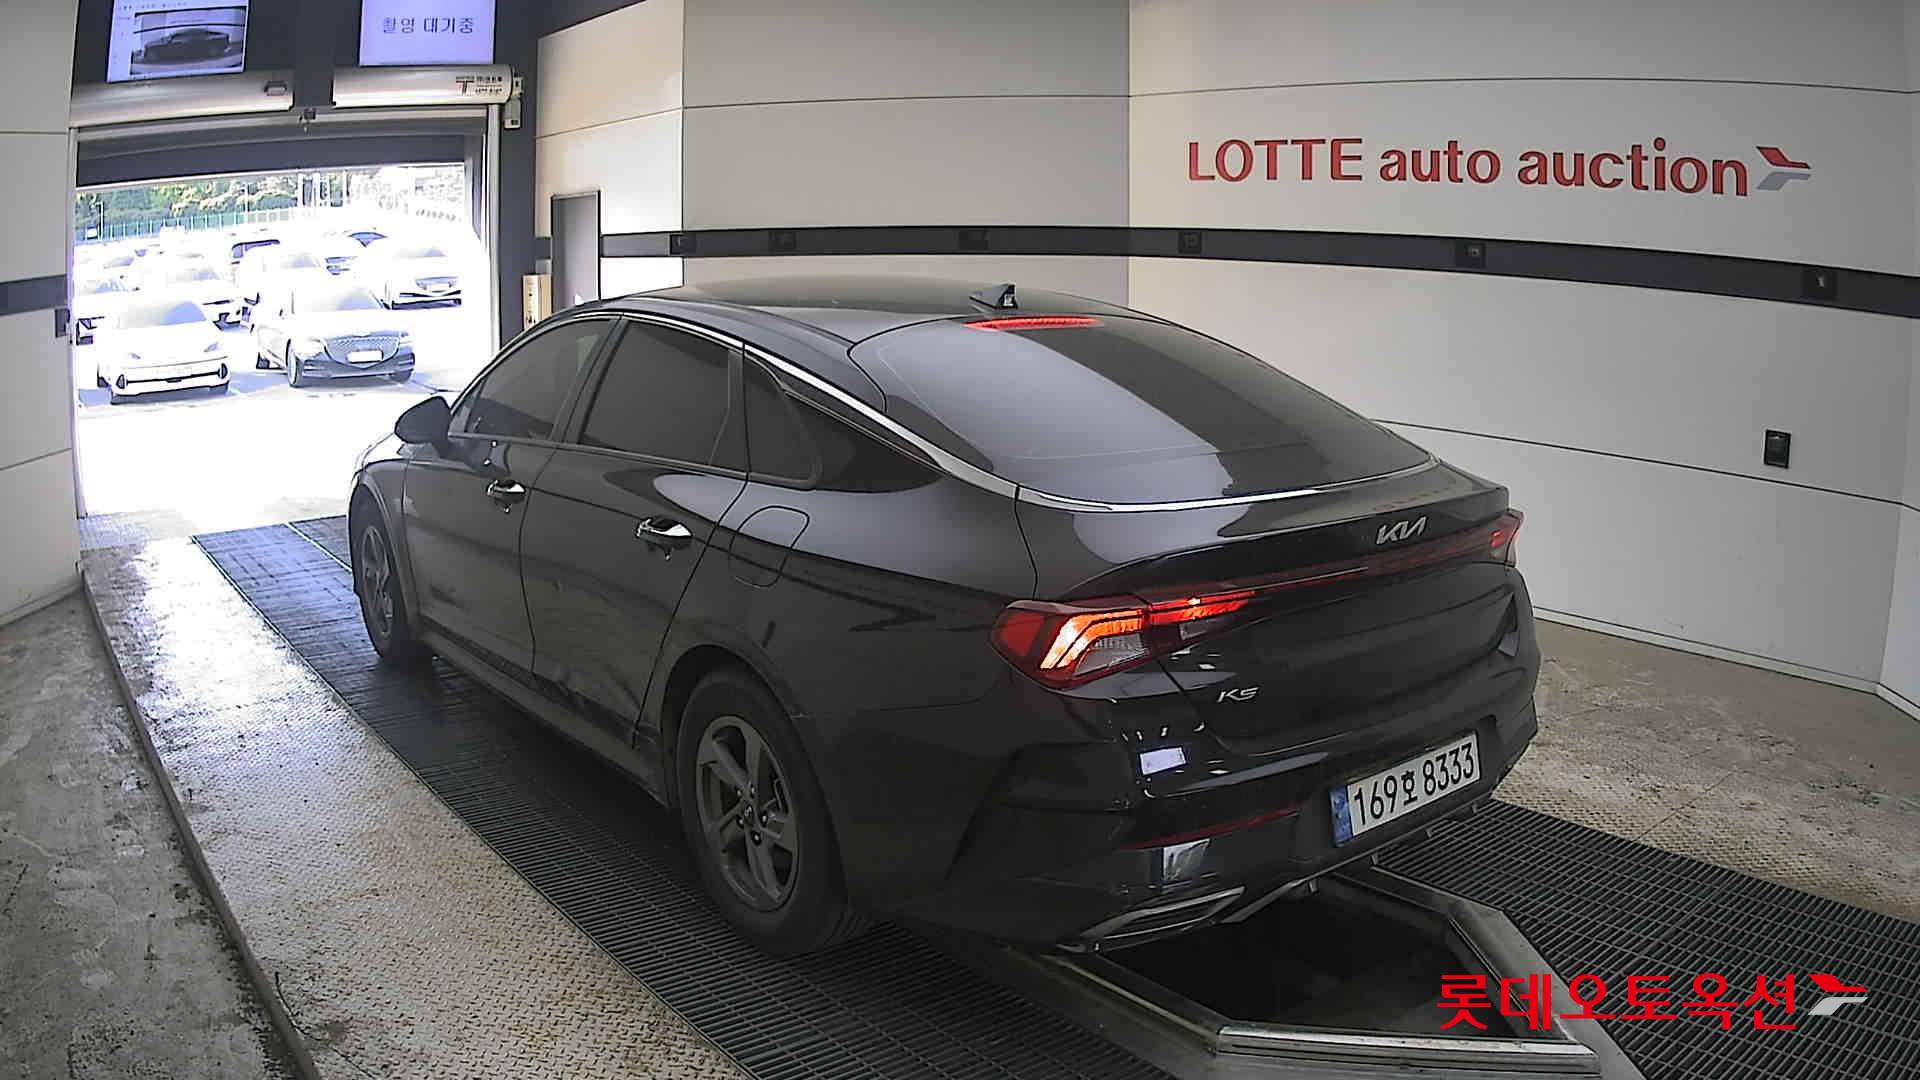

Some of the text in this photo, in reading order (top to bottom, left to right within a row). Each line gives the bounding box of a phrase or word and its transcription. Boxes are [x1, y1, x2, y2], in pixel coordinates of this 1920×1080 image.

[423, 17, 473, 34] 대기중
[1188, 137, 1748, 197] LOTTE auto auction
[1217, 686, 1260, 703] K5
[1353, 742, 1474, 826] 169호 8333
